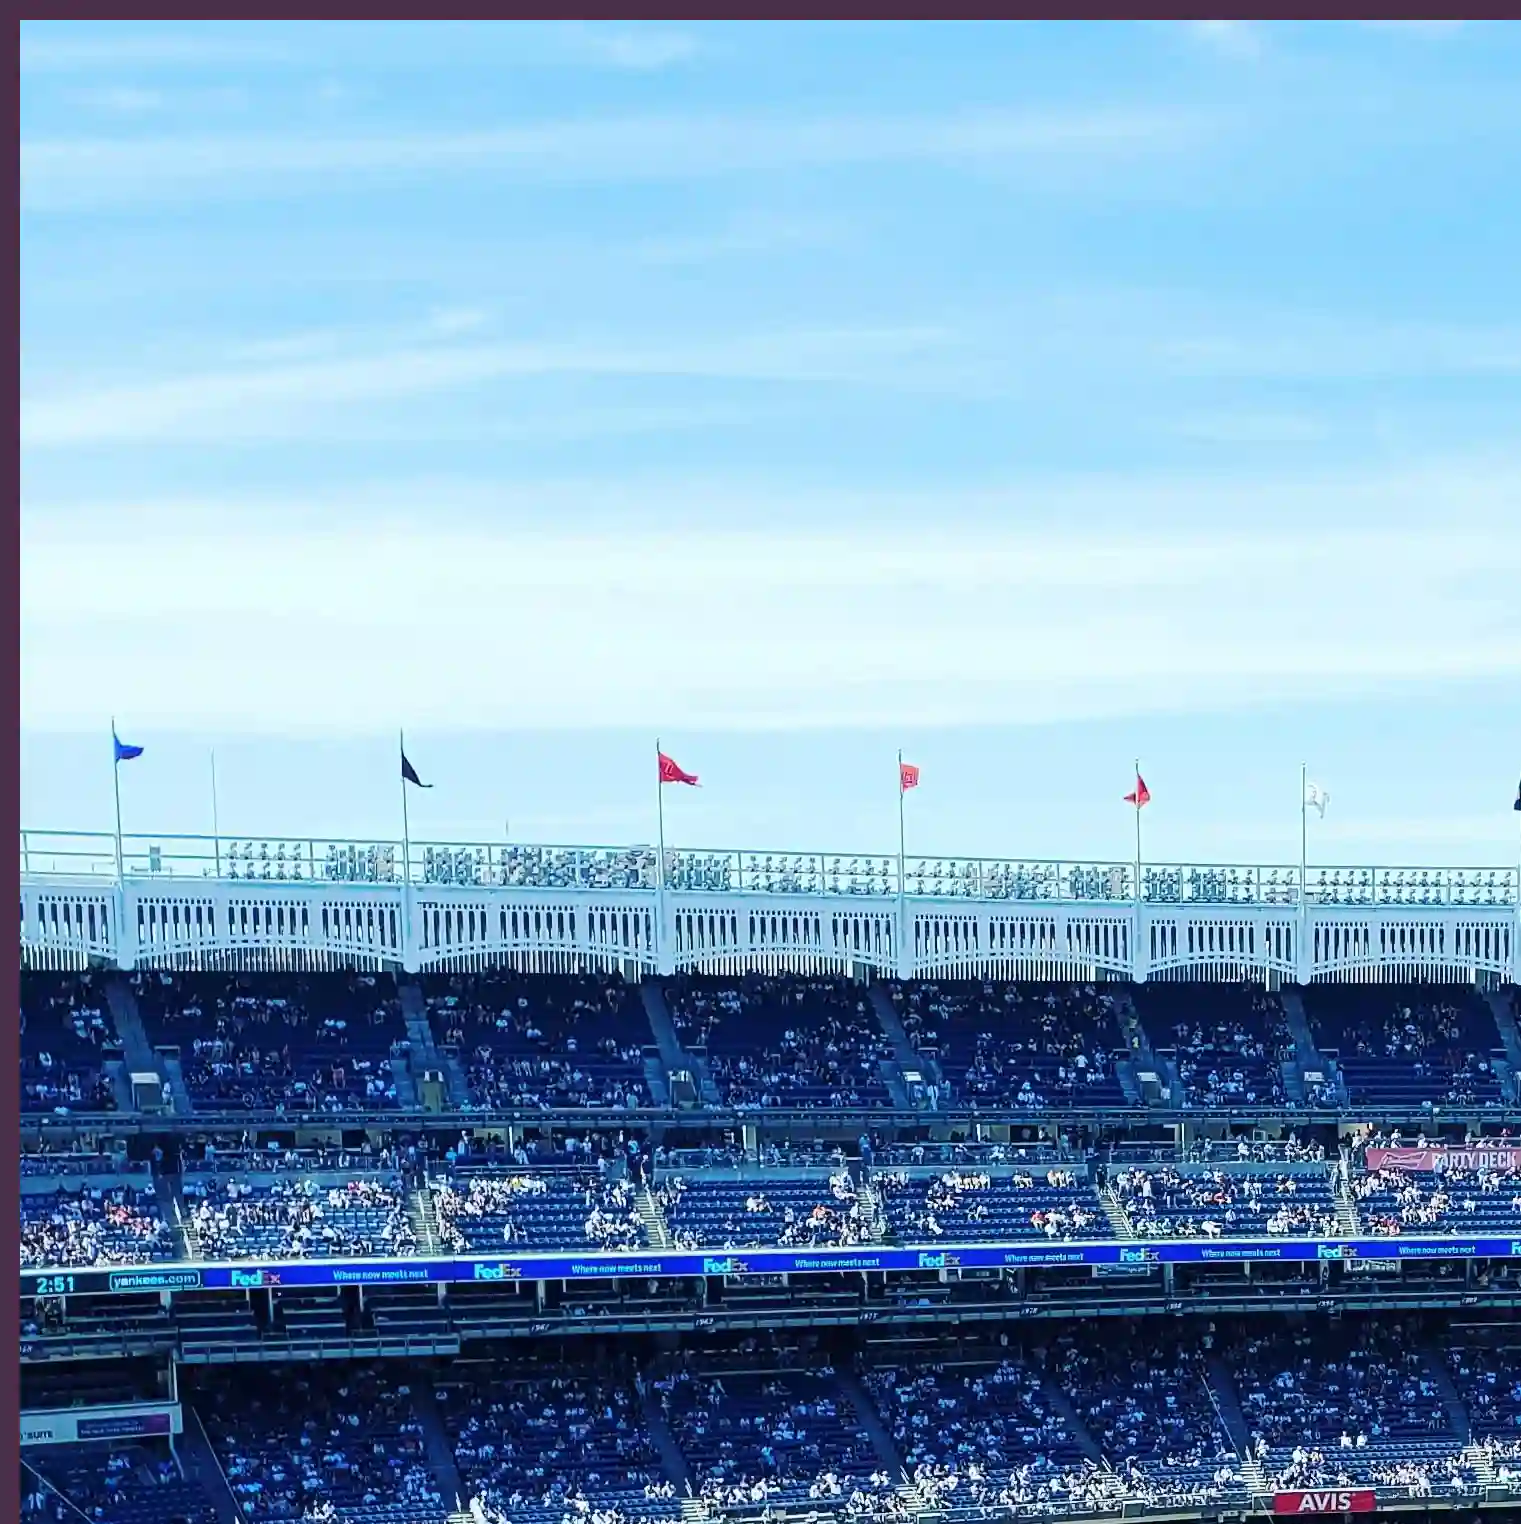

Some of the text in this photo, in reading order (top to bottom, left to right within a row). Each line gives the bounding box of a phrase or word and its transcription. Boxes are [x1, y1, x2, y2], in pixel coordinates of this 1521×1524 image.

[1432, 1150, 1517, 1169] PARTY DECK
[1120, 1248, 1160, 1262] FedEx
[1317, 1244, 1357, 1258] FedEx
[704, 1257, 748, 1273] FedEx
[919, 1252, 960, 1267] FedEx
[231, 1270, 281, 1286] FedEx
[474, 1263, 522, 1279] FedEx
[36, 1276, 75, 1294] 2:51
[113, 1273, 196, 1289] yankees.com
[1298, 1492, 1351, 1512] AVIS
